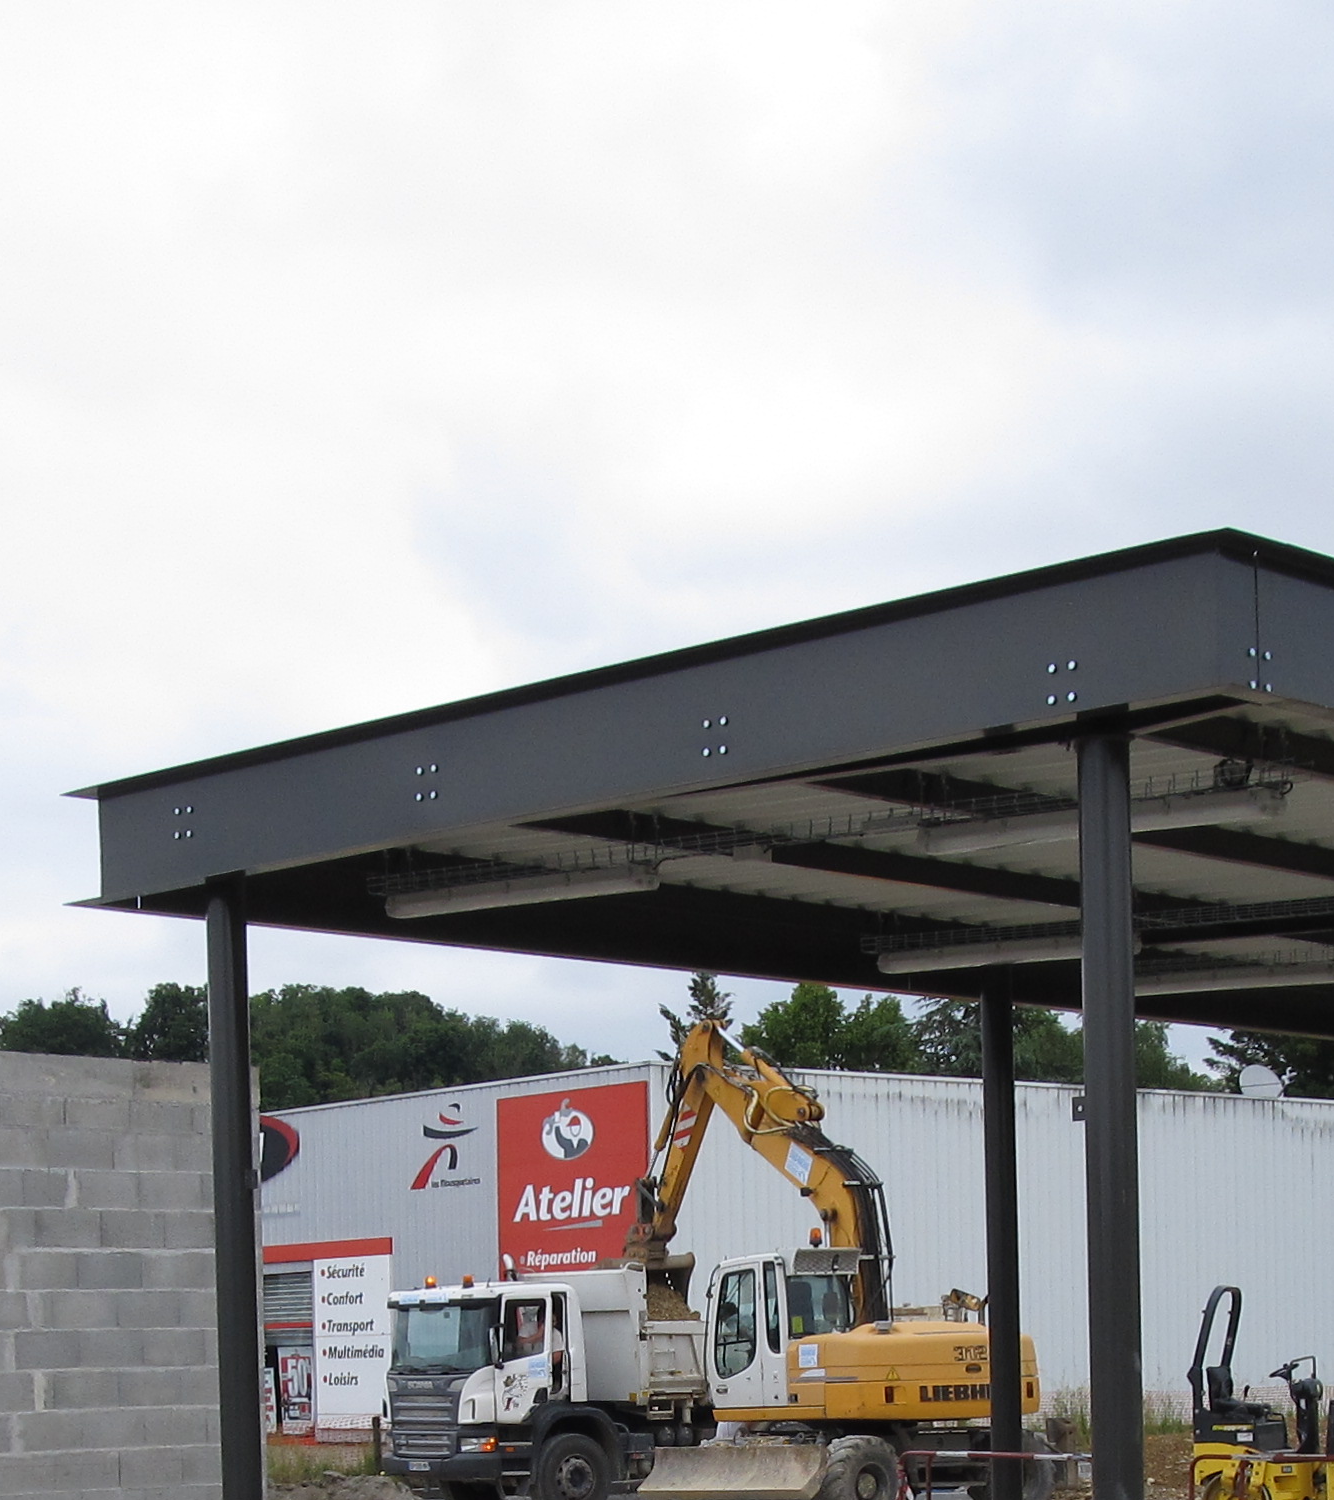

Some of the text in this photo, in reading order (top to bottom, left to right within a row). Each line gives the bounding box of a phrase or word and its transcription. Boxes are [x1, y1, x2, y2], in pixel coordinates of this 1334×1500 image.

[513, 1177, 630, 1222] Atelier
[527, 1247, 596, 1270] Réparation
[326, 1262, 365, 1279] Sécurité
[326, 1291, 364, 1306] Confort
[326, 1318, 374, 1336] Transport
[328, 1344, 385, 1359] Multimédia
[328, 1371, 359, 1386] Loisirs
[919, 1384, 990, 1402] LIEBH
